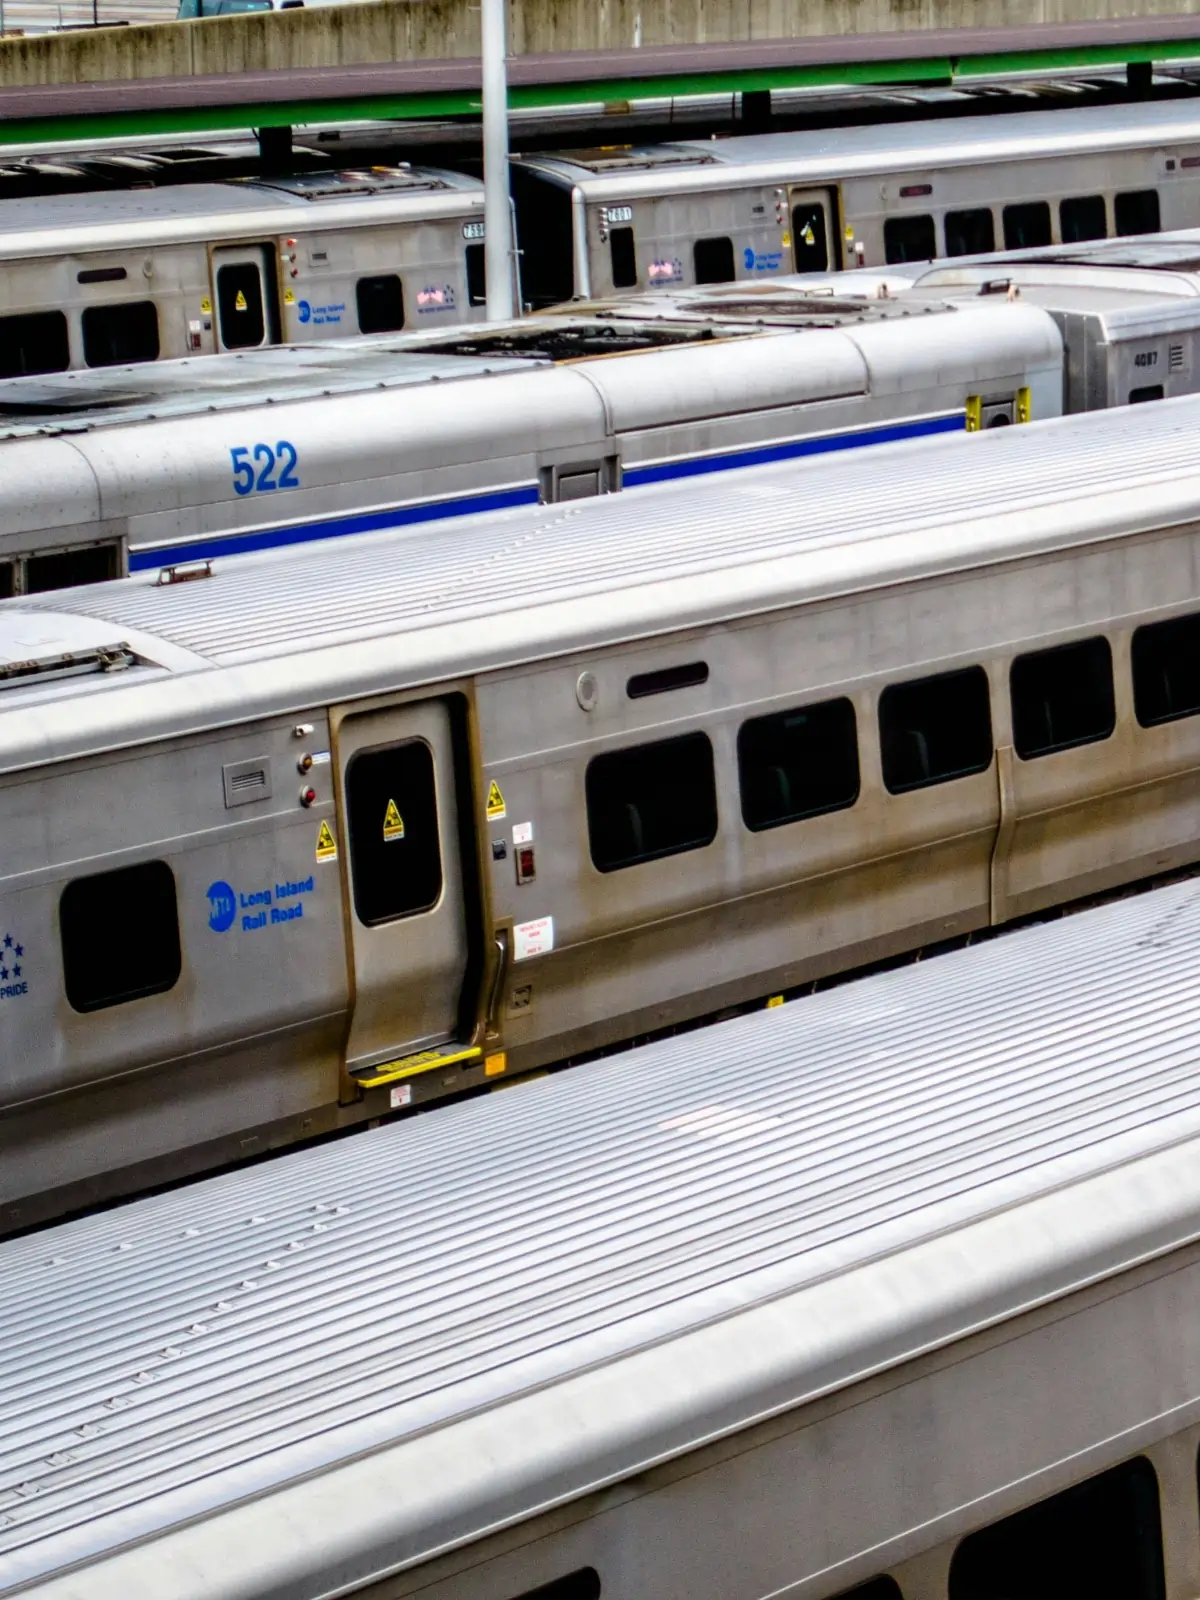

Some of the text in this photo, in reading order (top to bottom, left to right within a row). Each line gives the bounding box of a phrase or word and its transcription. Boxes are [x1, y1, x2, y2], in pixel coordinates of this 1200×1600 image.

[230, 440, 299, 495] 522
[240, 876, 314, 908] Long Island
[242, 902, 303, 931] Rail Road
[0, 981, 28, 999] PRIDE
